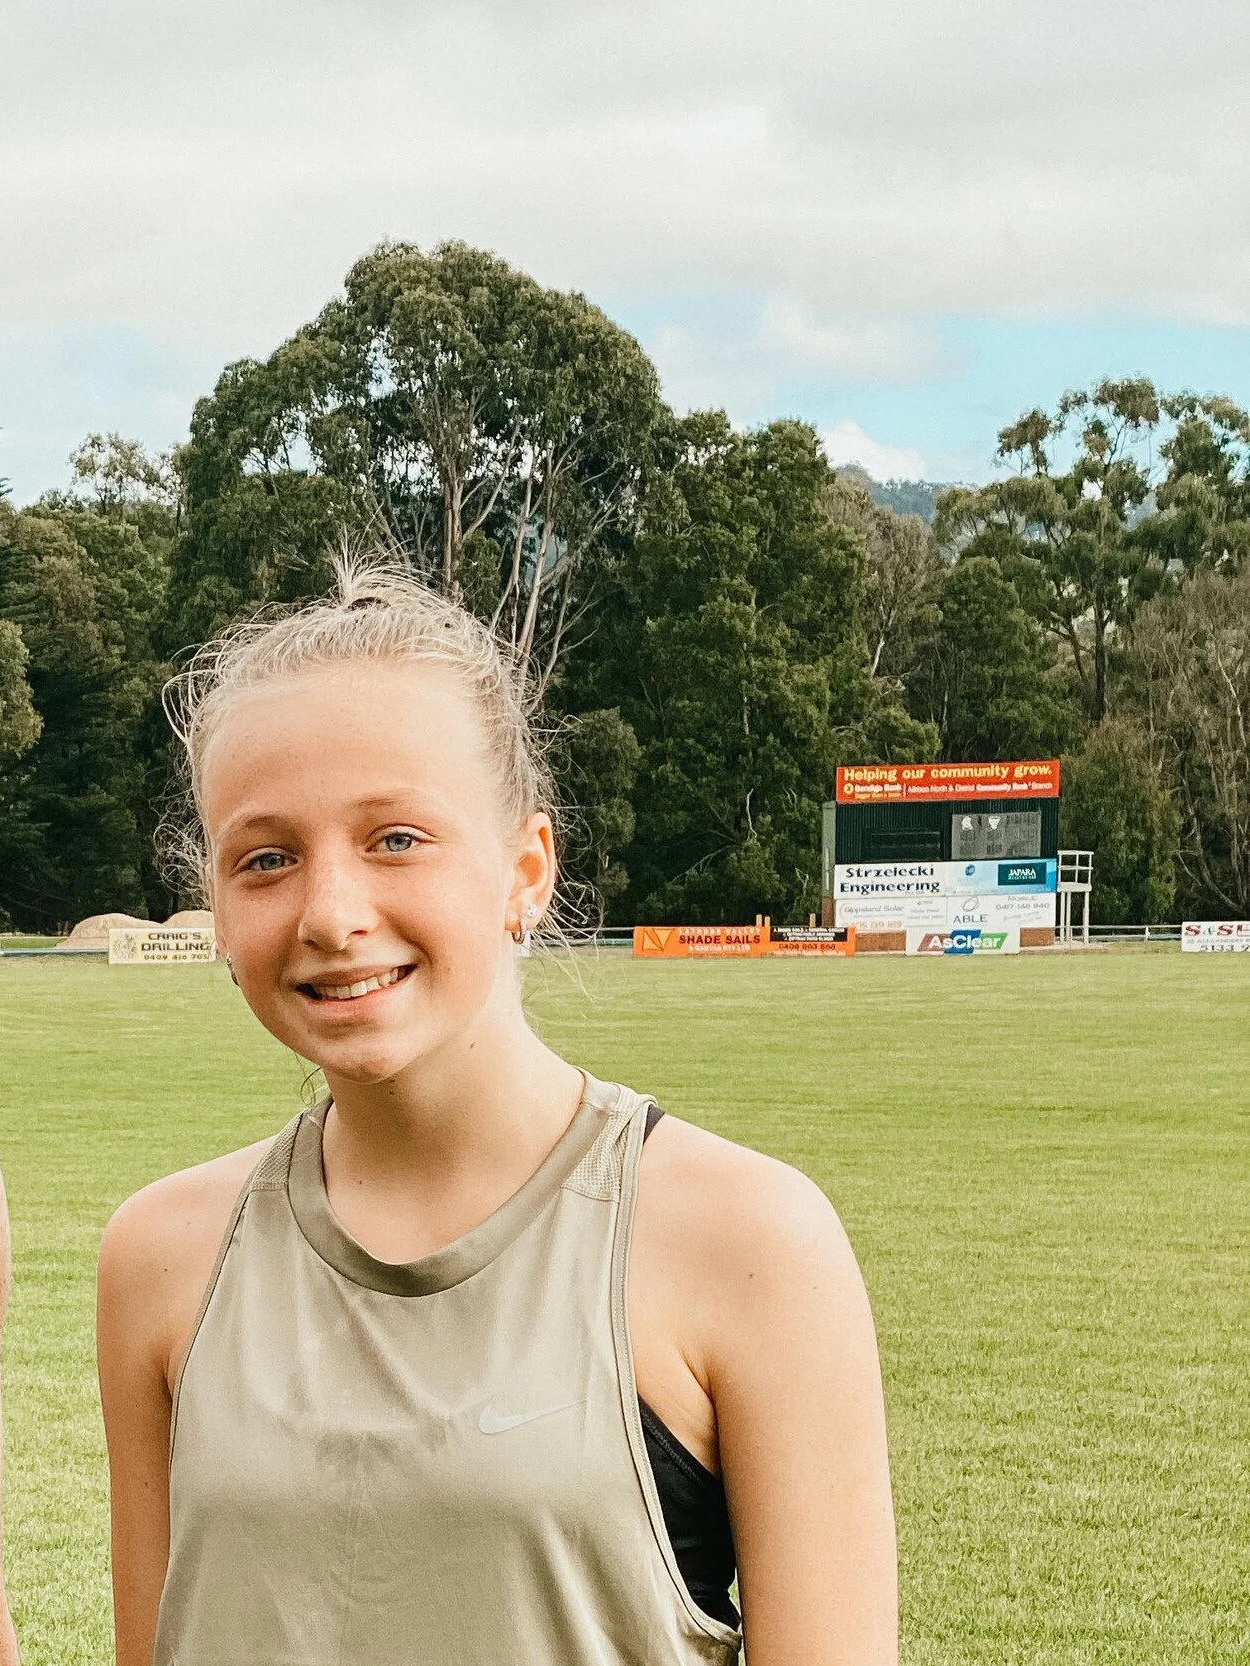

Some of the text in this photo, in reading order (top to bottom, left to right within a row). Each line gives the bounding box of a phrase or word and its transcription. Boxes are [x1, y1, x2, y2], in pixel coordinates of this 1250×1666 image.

[844, 764, 1053, 782] Helping our community grow.
[846, 865, 934, 878] Strzelecki
[840, 881, 940, 895] Engineering
[953, 914, 988, 924] ABLE
[148, 932, 202, 940] CRAIG'S
[1185, 925, 1201, 936] S
[1217, 925, 1233, 936] S
[679, 935, 761, 944] SHADE SAILS
[929, 935, 1001, 949] AsClear
[141, 942, 210, 951] DRILLING
